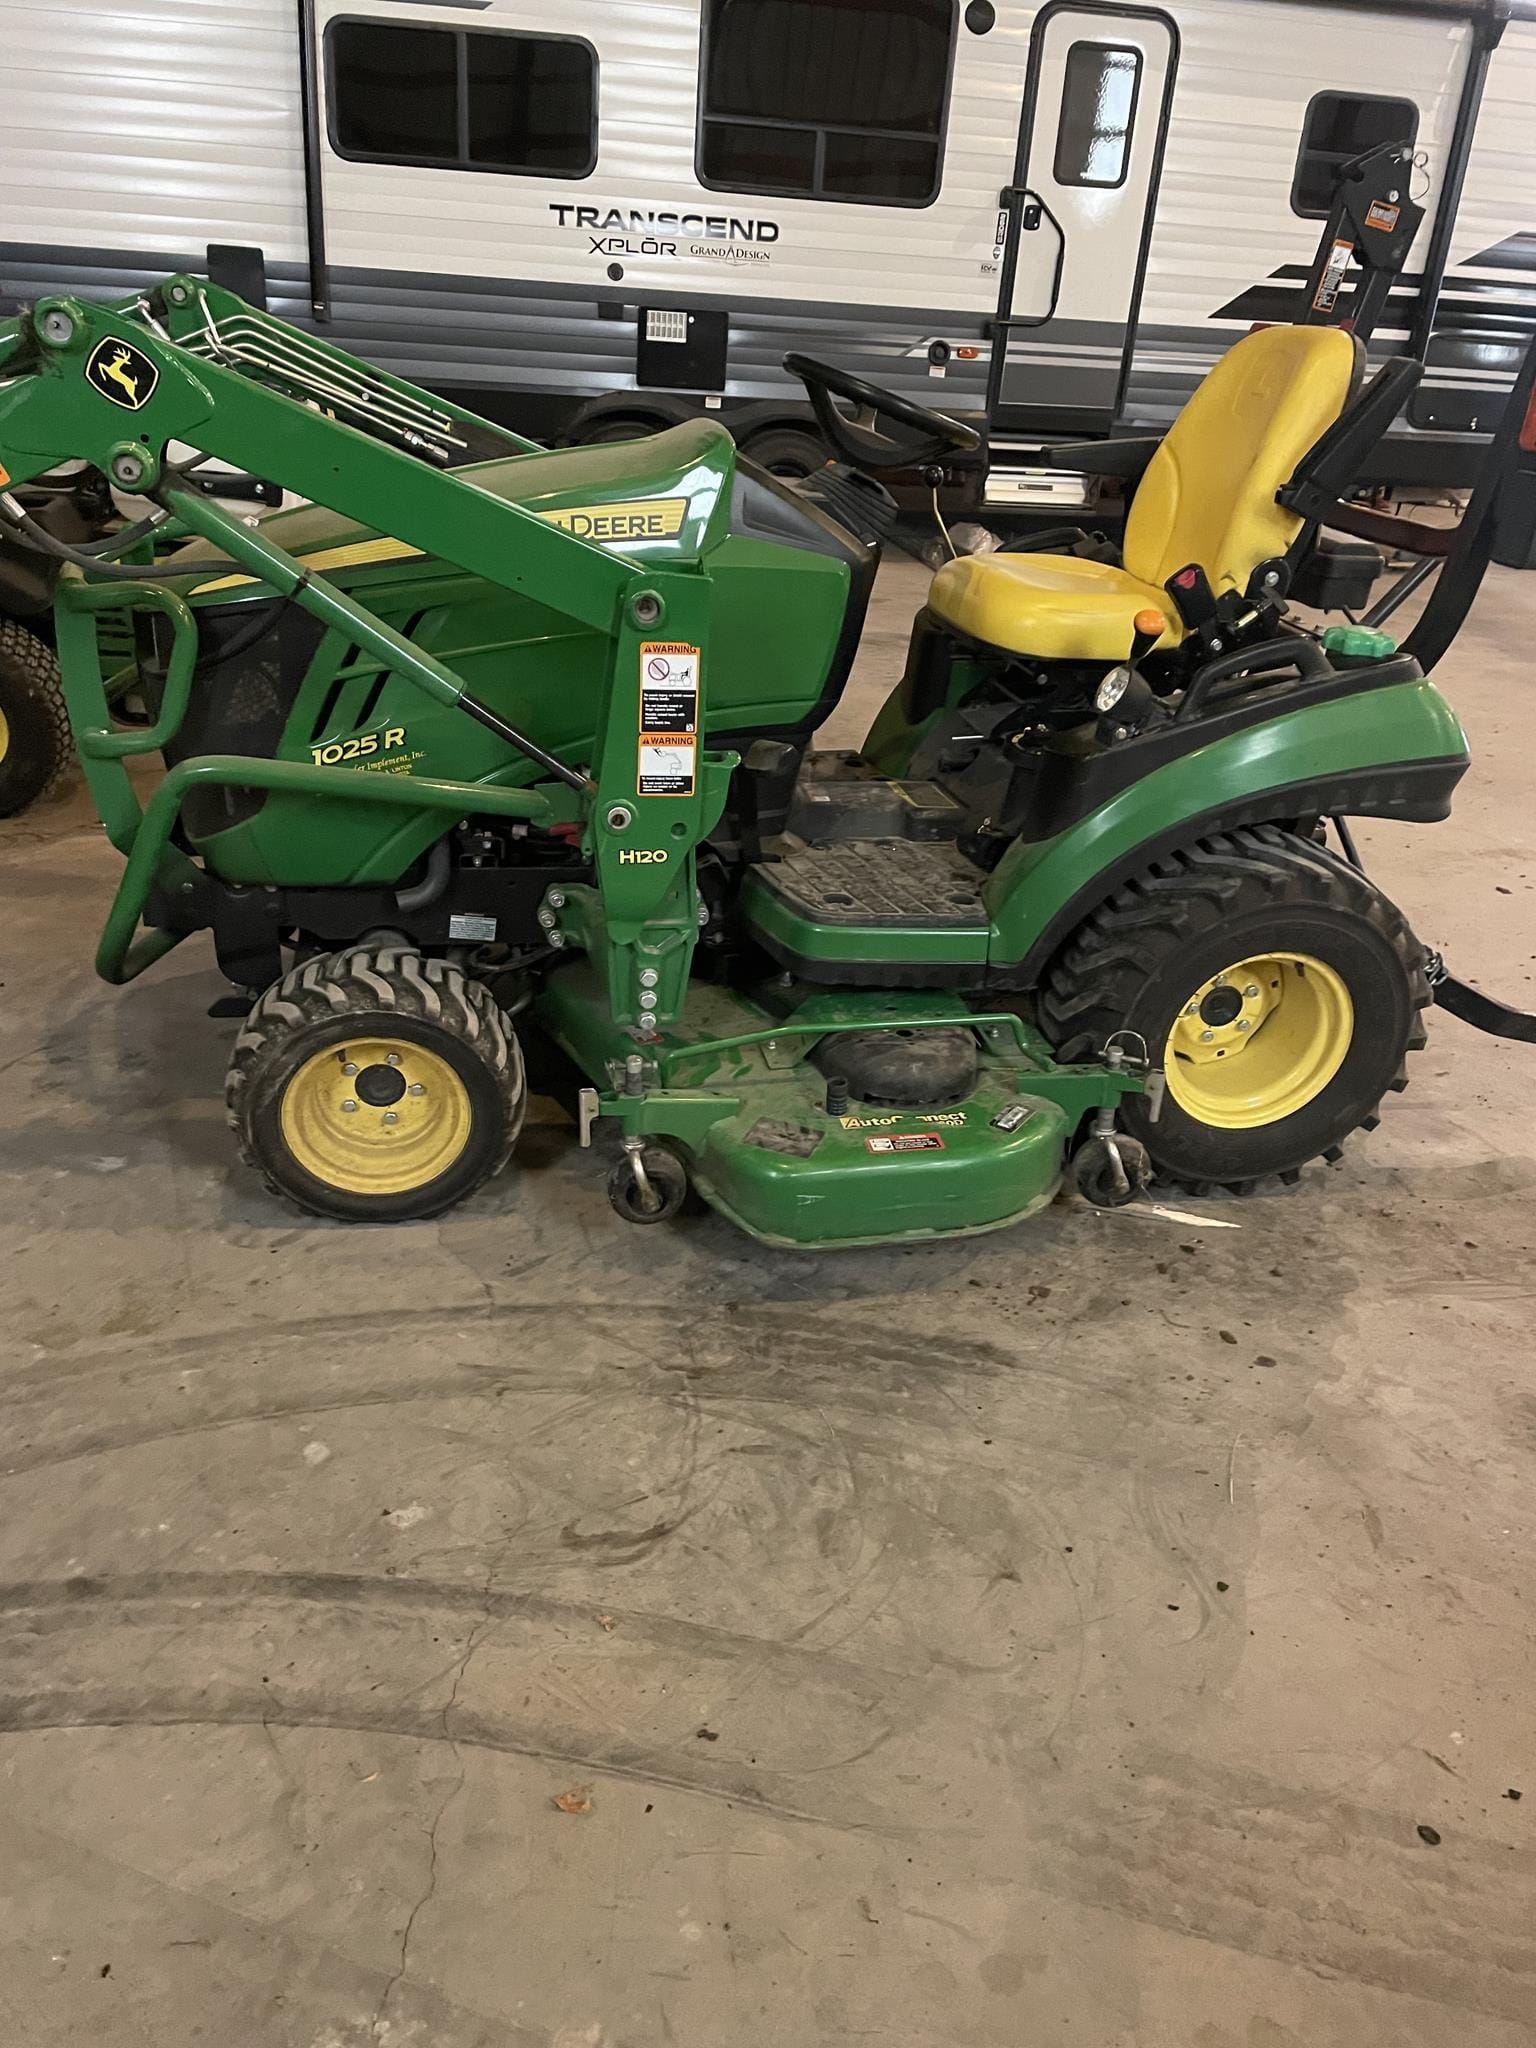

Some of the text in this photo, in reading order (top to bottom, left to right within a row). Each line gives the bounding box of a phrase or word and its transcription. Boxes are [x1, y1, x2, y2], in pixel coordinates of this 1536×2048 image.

[549, 203, 779, 242] TRANSCEND
[570, 514, 663, 536] DEERE
[652, 645, 697, 653] WARNING
[312, 728, 405, 766] 1025 R
[651, 737, 693, 745] WARNING
[619, 849, 668, 864] H120
